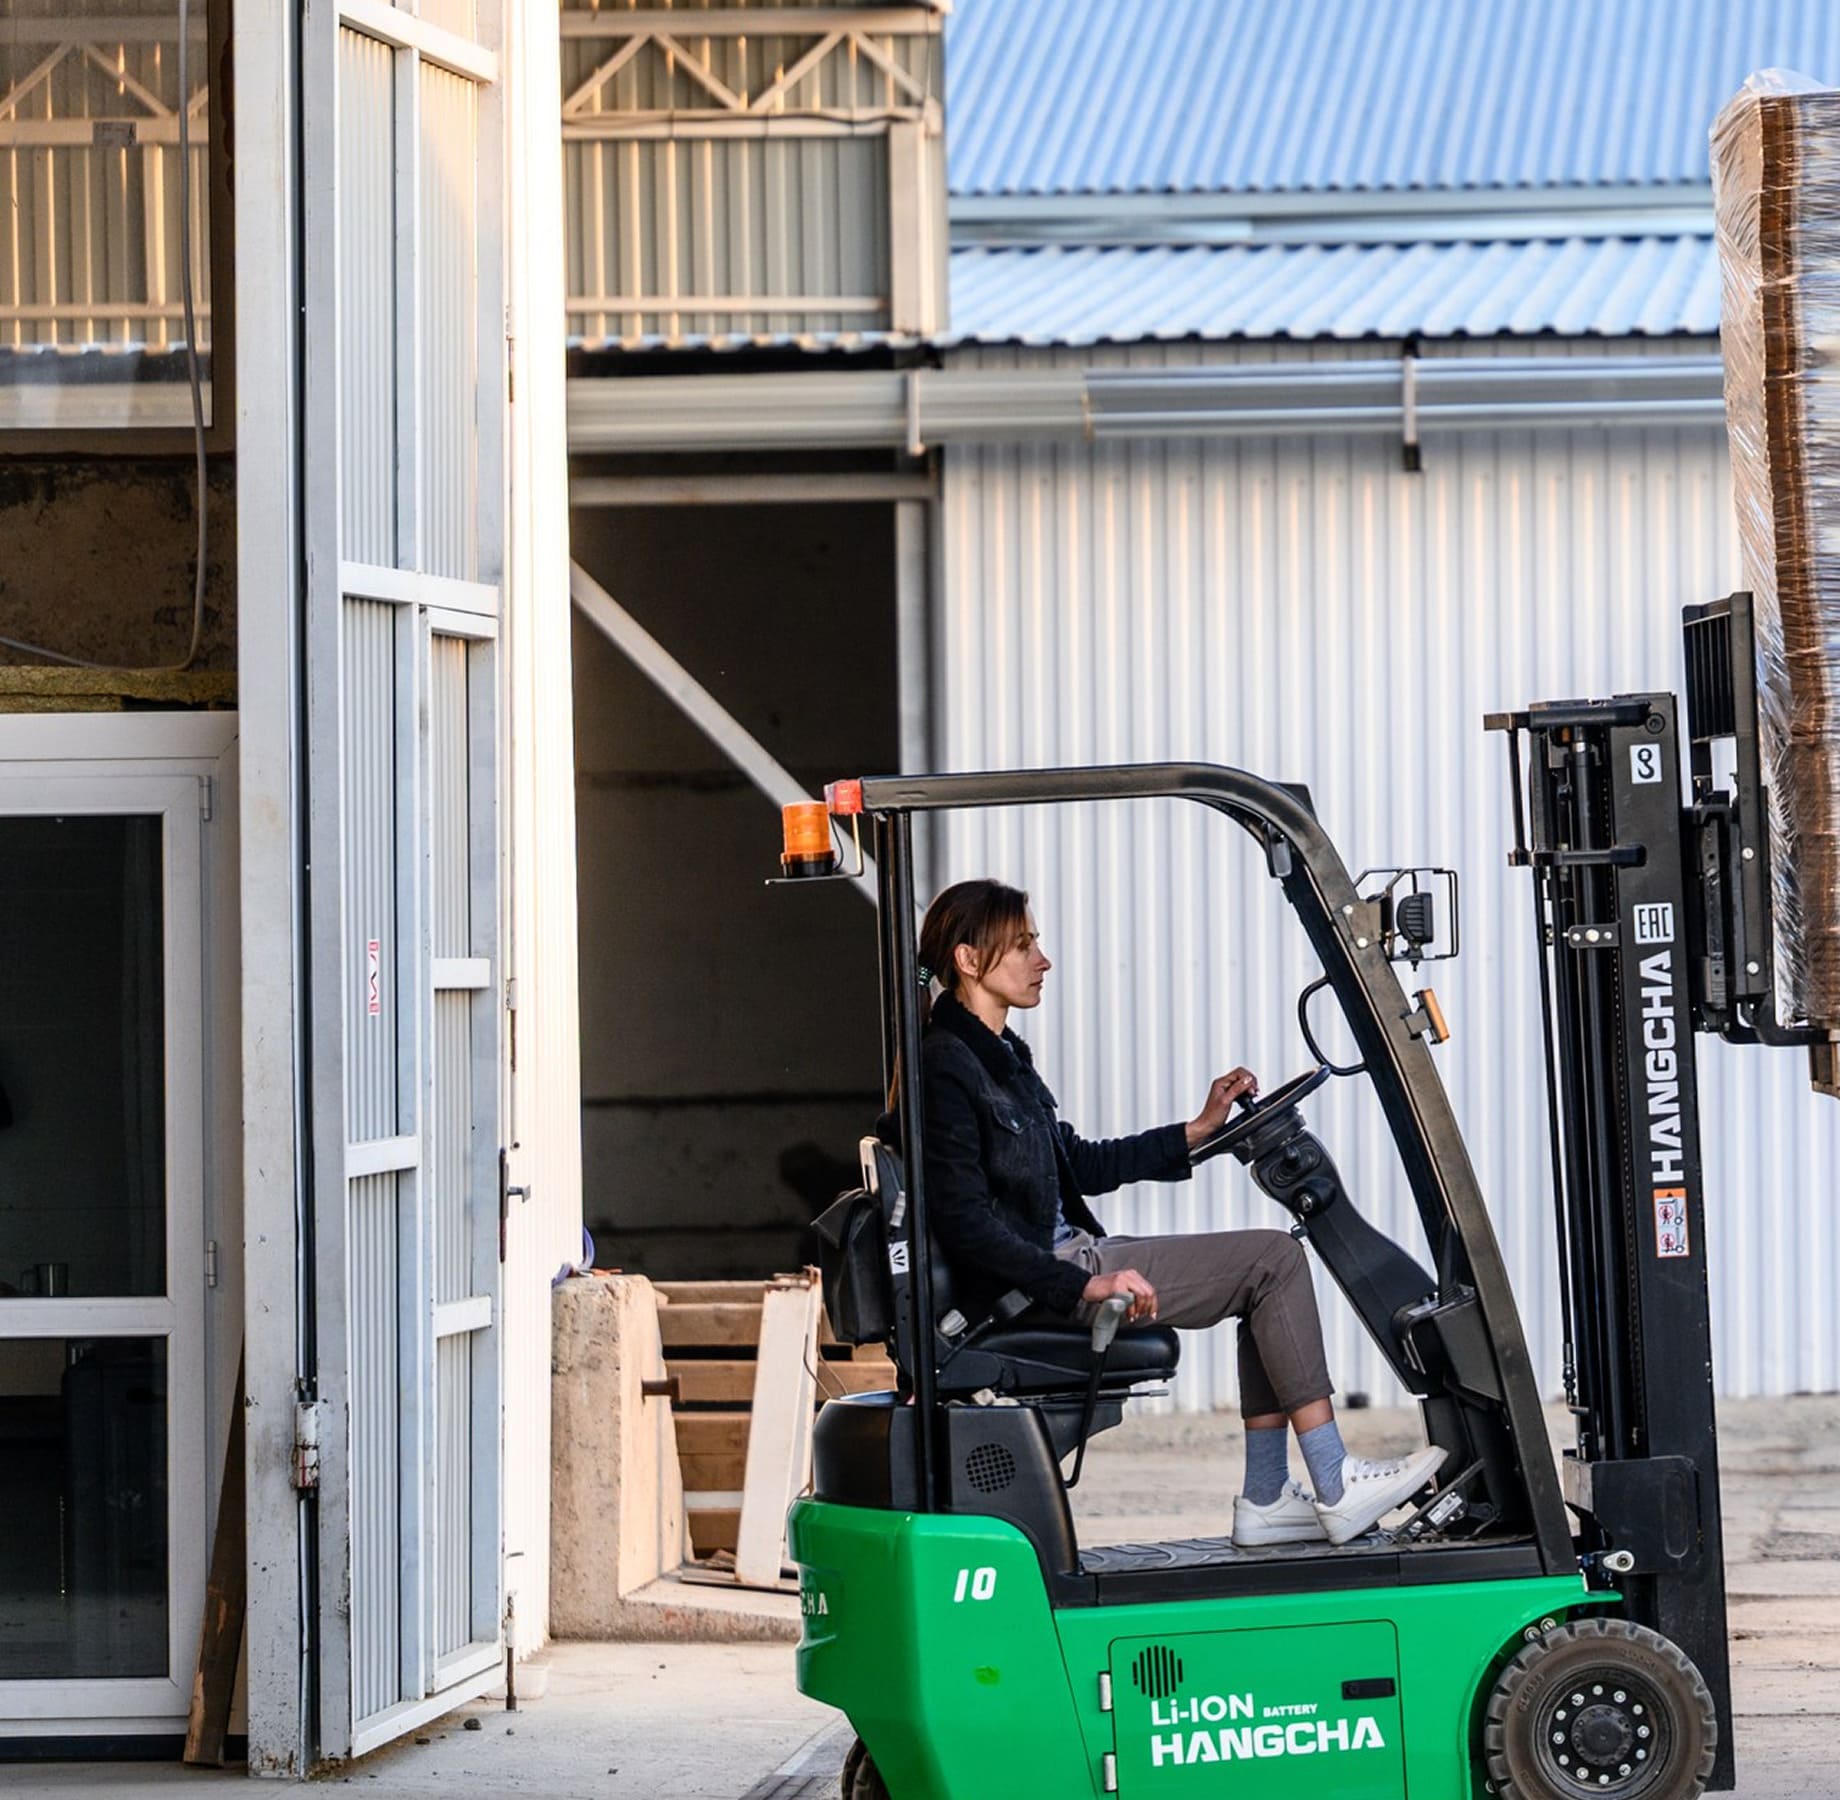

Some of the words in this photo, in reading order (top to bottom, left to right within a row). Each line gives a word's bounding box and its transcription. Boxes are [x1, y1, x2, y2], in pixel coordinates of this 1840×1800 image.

[1638, 906, 1670, 938] EAC
[1639, 950, 1684, 1182] HANGCHA
[953, 1567, 996, 1603] 10
[1151, 1693, 1254, 1726] Li-ION
[1263, 1703, 1318, 1718] BATTERY
[1151, 1716, 1385, 1767] HANGCHA
